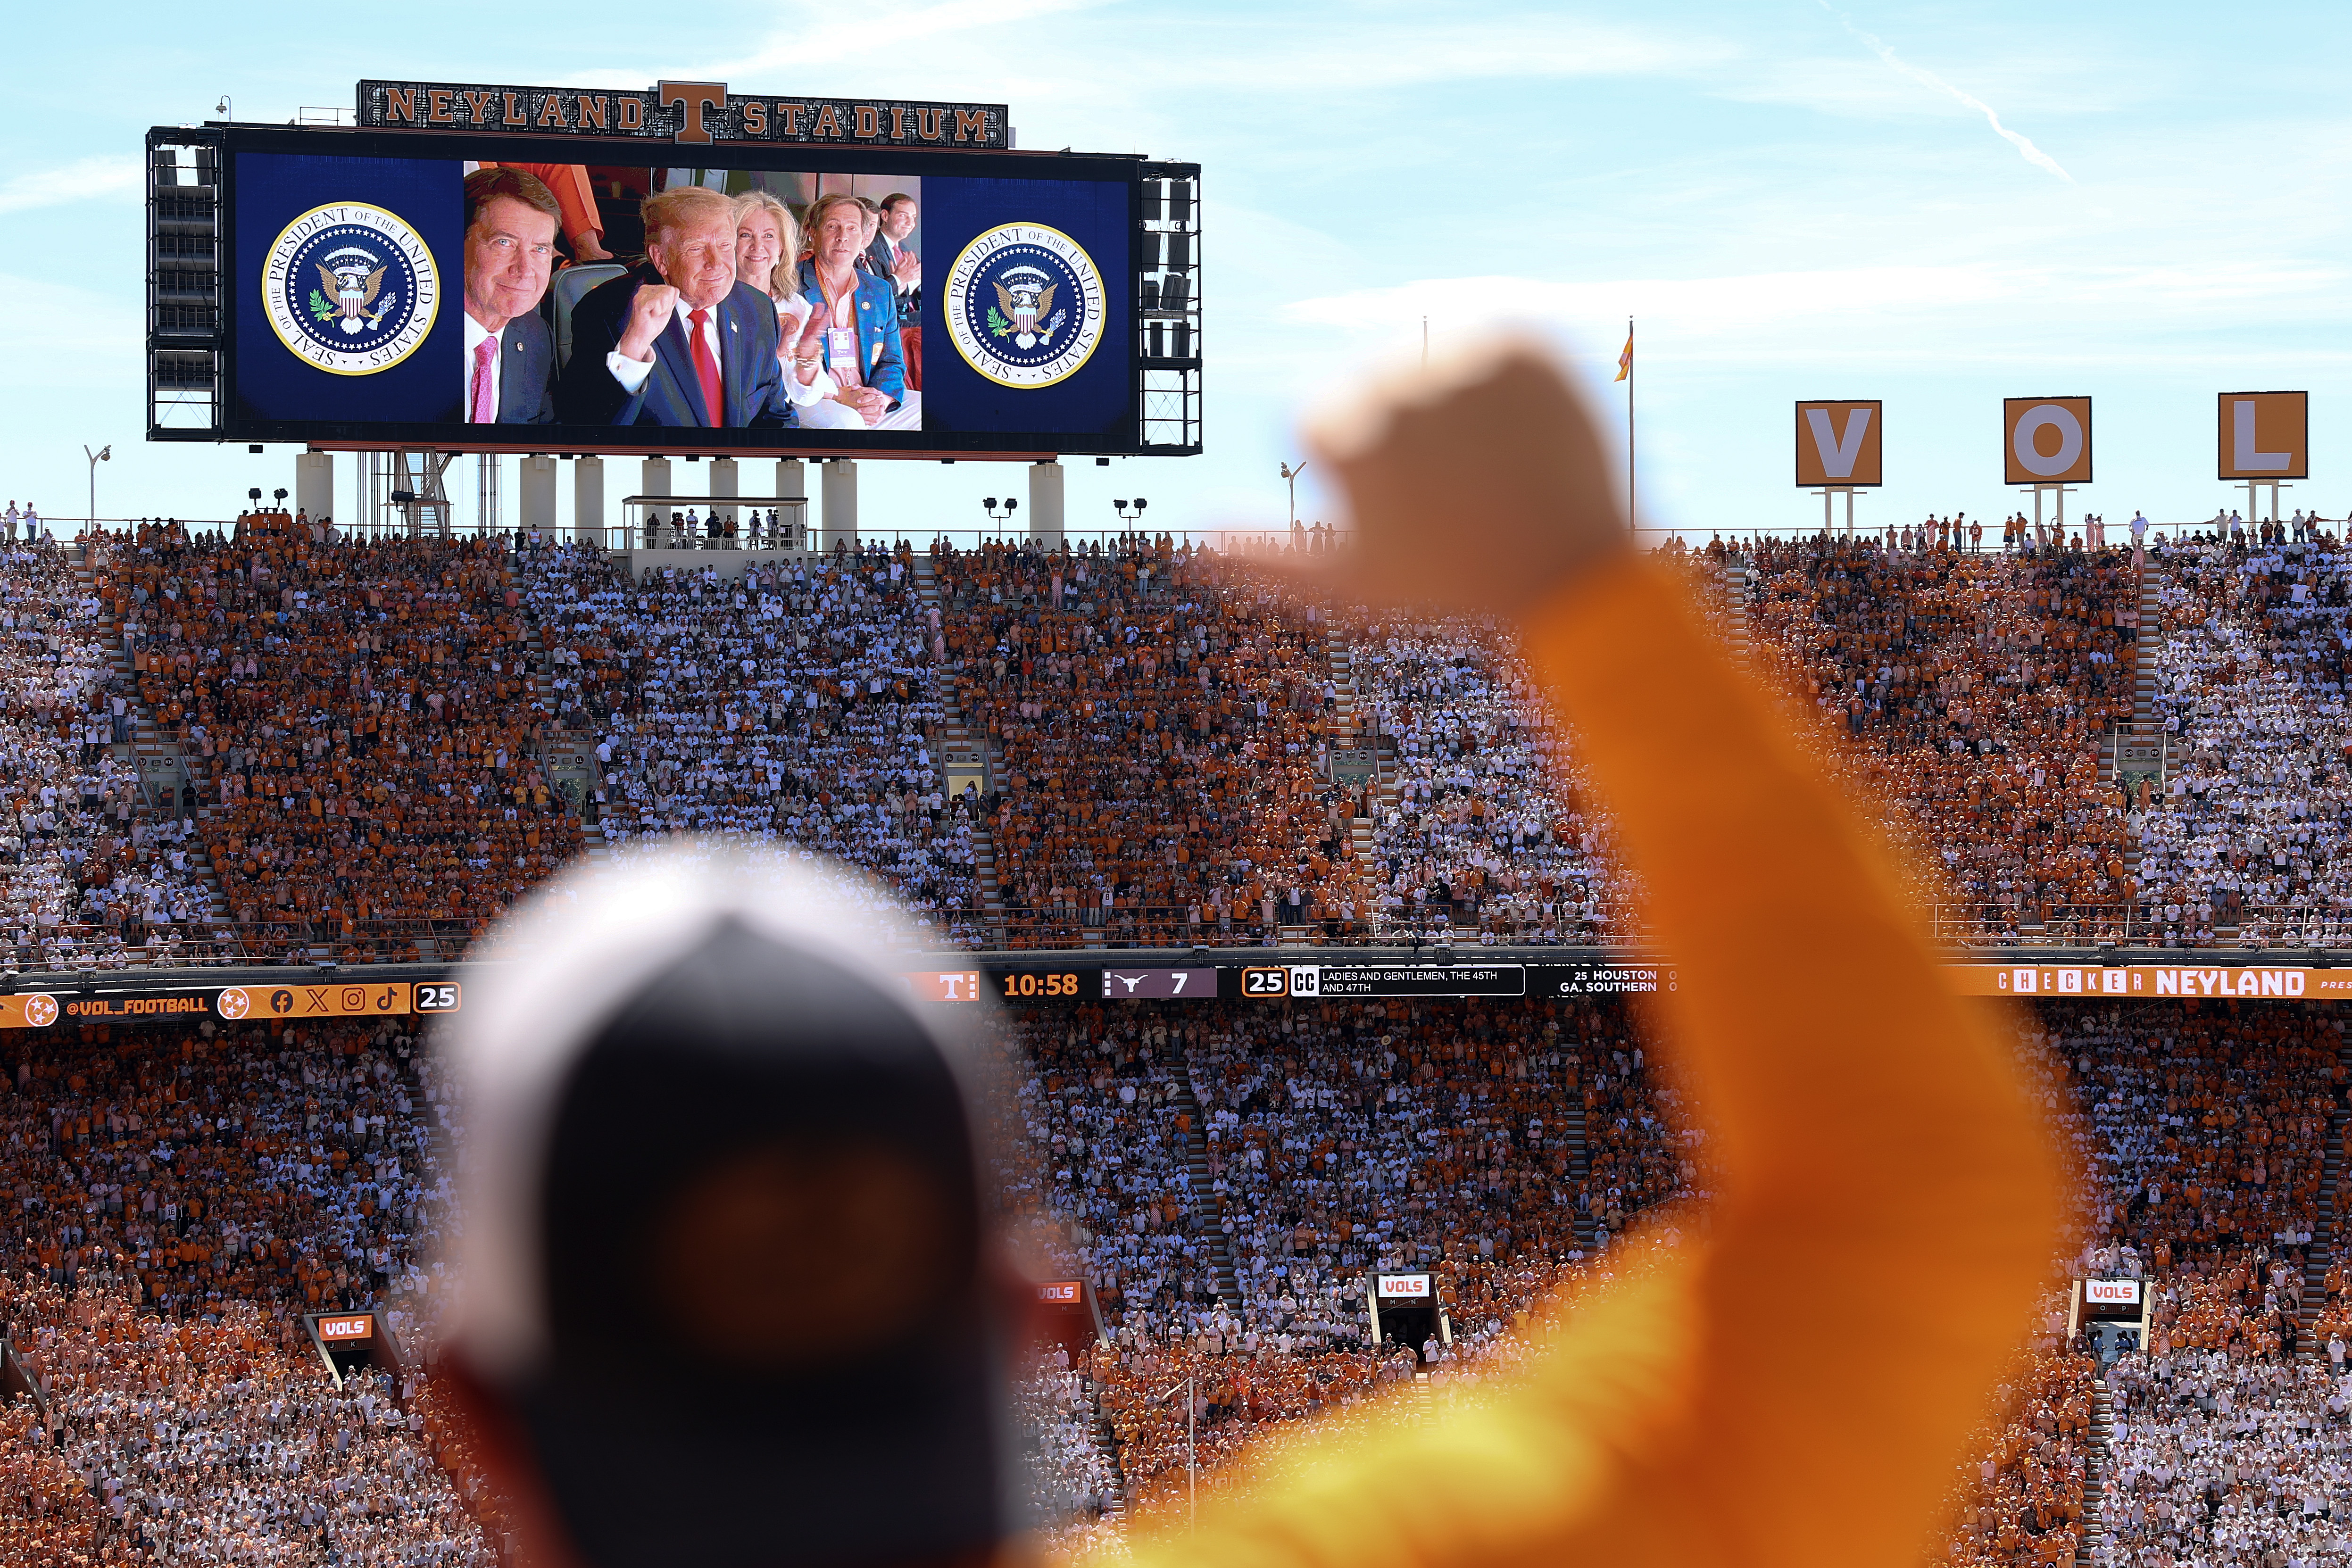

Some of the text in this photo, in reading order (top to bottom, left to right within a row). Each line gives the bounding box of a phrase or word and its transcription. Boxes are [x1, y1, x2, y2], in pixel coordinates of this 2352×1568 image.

[386, 81, 988, 145] NEYLAND T STADIUM
[270, 208, 433, 365] SEAL OF THE PRESIDENT OF THE UNITED STATES
[951, 228, 1100, 380] SEAL OF THE PRESIDENT OF THE UNITED STATES
[1805, 401, 2292, 477] V O L
[1172, 973, 1188, 994] 7
[1249, 974, 1282, 991] 25
[1294, 973, 1314, 991] CC
[1323, 971, 1497, 981] LADIES AND GENTLEMEN, THE 45TH
[1575, 972, 1587, 980] 25
[1594, 971, 1657, 980] HOUSTON
[1998, 971, 2142, 990] CHECKER
[2157, 971, 2304, 996] NEYLAND
[1005, 974, 1078, 996] 10:58
[1323, 984, 1371, 992] AND 47TH
[1560, 983, 1582, 992] GA.
[1586, 982, 1657, 992] SOUTHERN
[421, 987, 456, 1006] 25
[67, 998, 208, 1017] @VOL_FOOTBALL
[279, 1196, 282, 1204] 1
[376, 1256, 382, 1264] 16
[1038, 1287, 1073, 1299] VOLS
[1386, 1281, 1422, 1292] VOLS
[2094, 1286, 2132, 1298] VOLS
[326, 1321, 364, 1336] VOLS
[165, 1370, 169, 1378] 6
